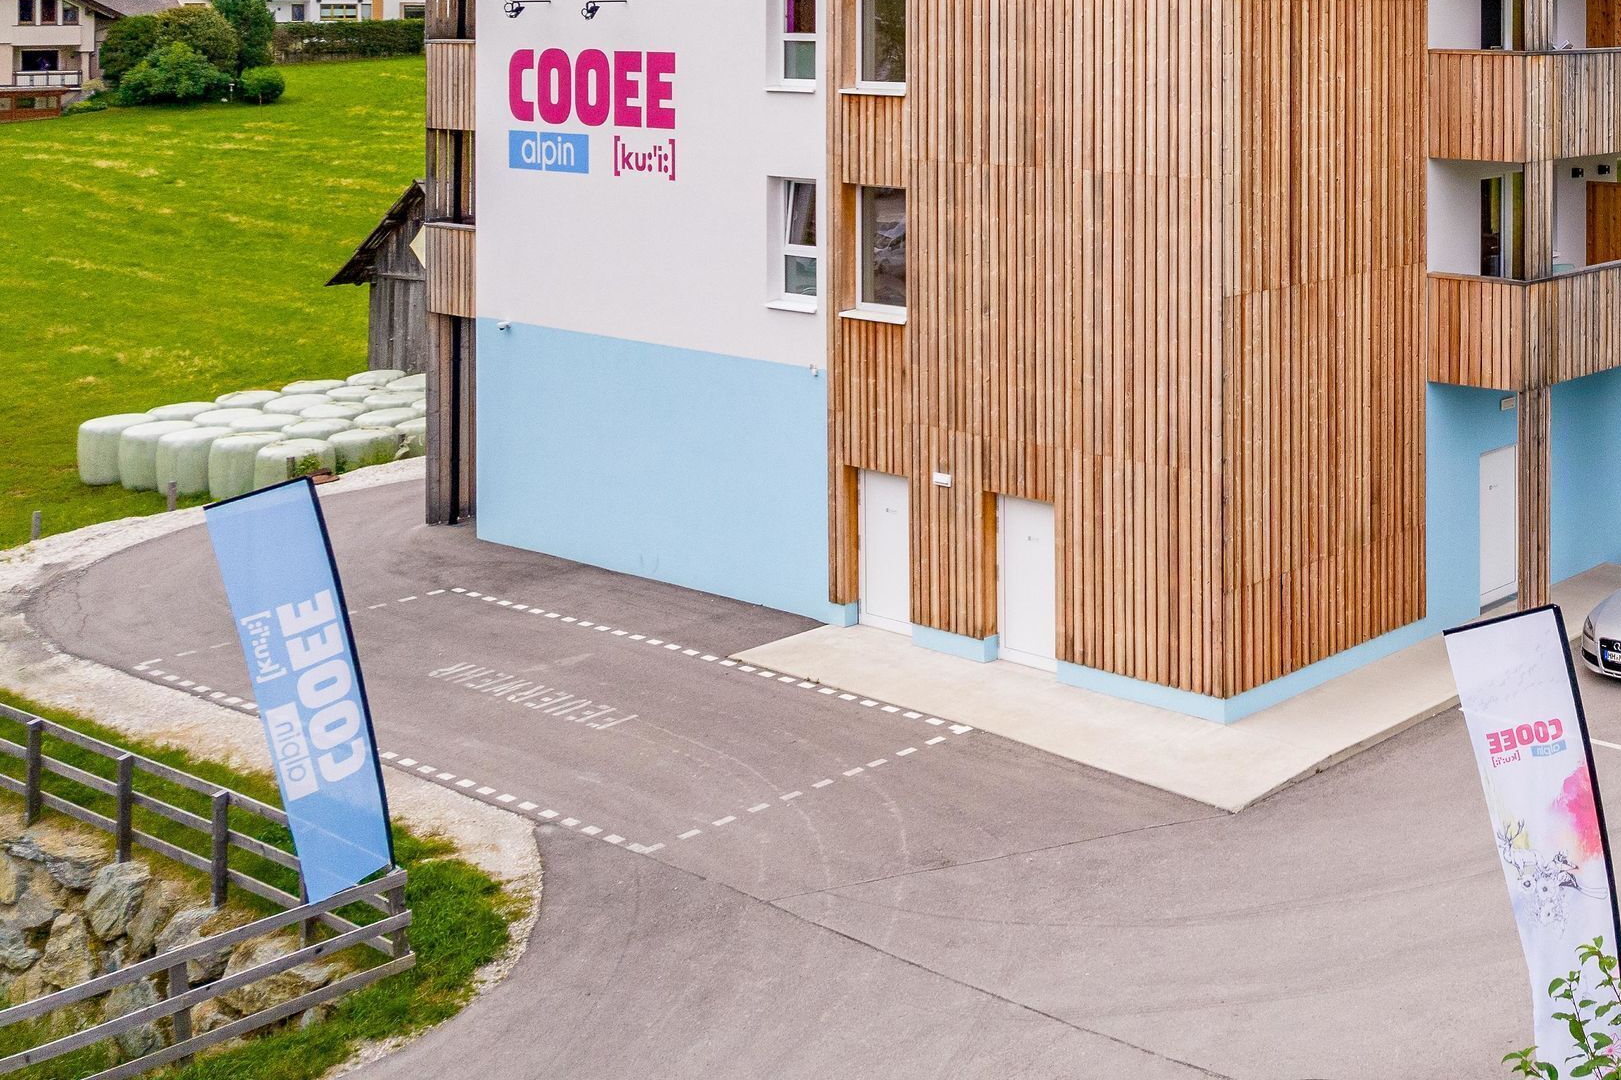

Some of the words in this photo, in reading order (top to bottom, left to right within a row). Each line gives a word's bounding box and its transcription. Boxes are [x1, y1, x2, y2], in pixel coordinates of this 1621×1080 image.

[509, 48, 676, 130] COOEE
[521, 132, 575, 171] alpin
[428, 661, 639, 730] FEUERWEHR
